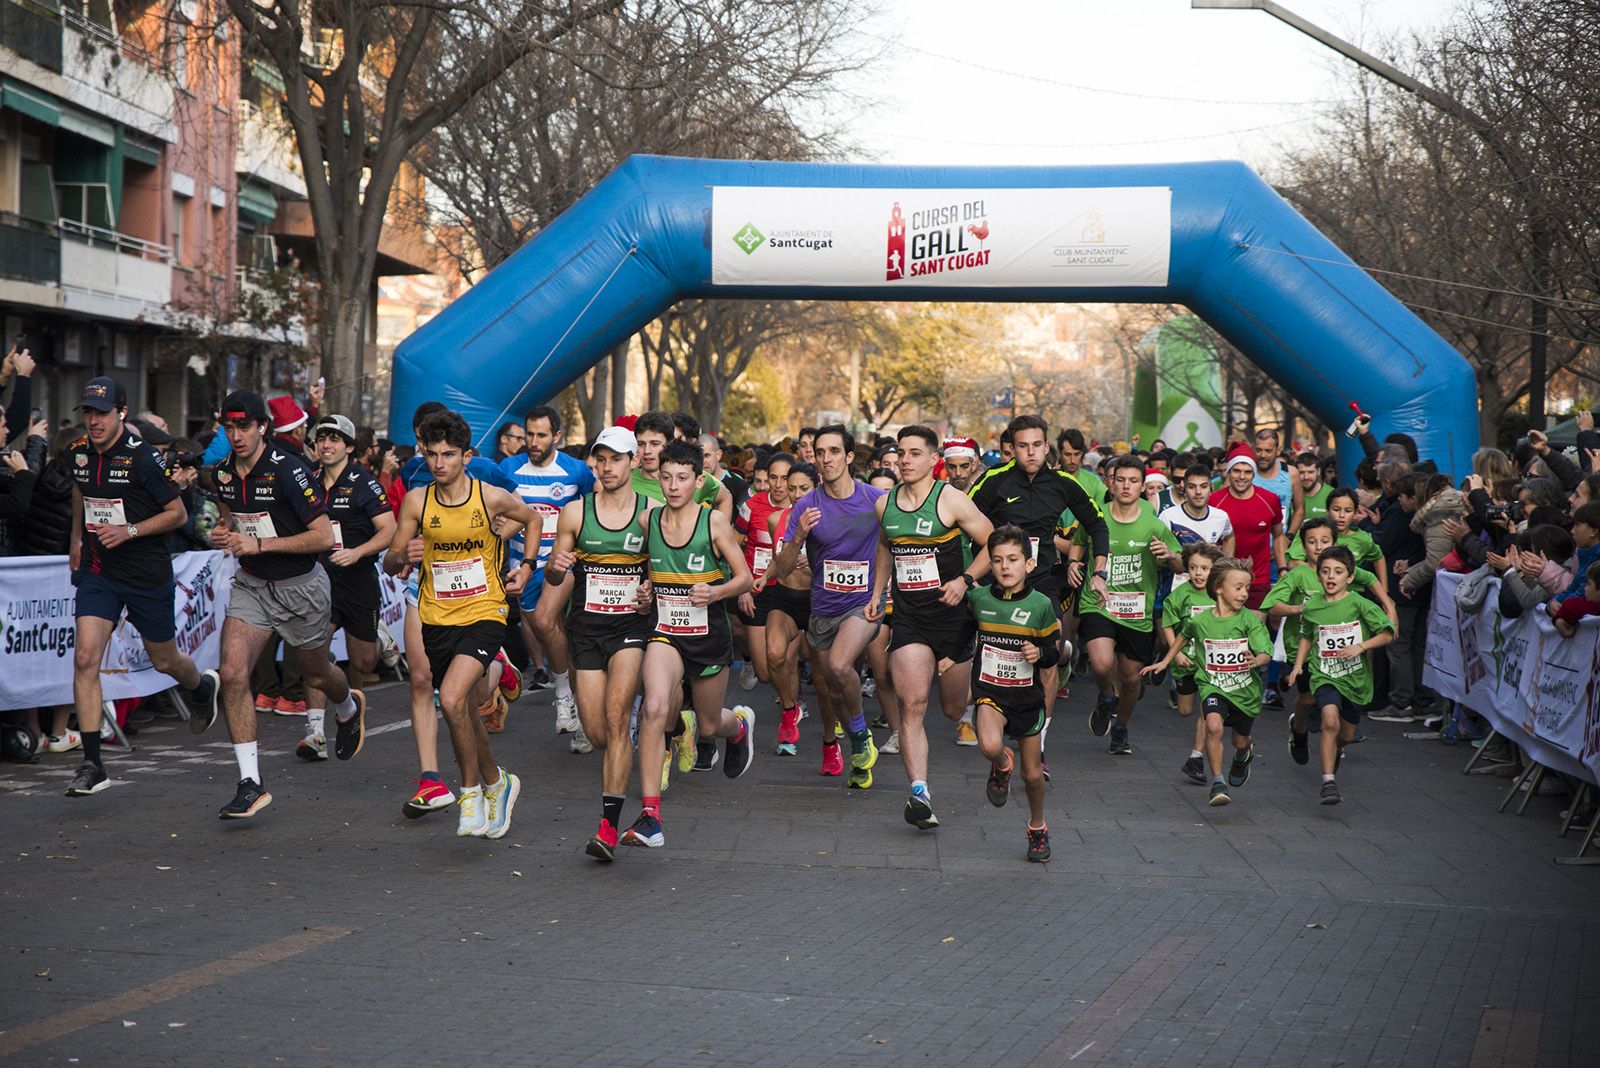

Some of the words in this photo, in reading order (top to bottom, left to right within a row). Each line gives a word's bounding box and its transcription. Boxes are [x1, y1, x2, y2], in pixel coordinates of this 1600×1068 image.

[912, 205, 958, 230] CURSA
[963, 200, 987, 221] DEL
[769, 230, 821, 238] AJUNTAMENT
[769, 238, 833, 251] SantCugat
[911, 226, 969, 260] GALL
[1054, 248, 1073, 256] CLUB
[1074, 248, 1128, 256] MUNTANYENC
[910, 258, 945, 277] SANT
[947, 249, 990, 271] CUGAT
[93, 510, 112, 518] MATIAS
[433, 538, 484, 553] ASMON
[1112, 562, 1135, 575] GALL
[828, 572, 864, 585] 1031
[450, 581, 469, 590] 811
[602, 597, 622, 605] 457
[7, 599, 69, 620] AJUNTAMENT
[670, 610, 690, 618] ADRIA
[671, 618, 690, 626] 376
[5, 623, 75, 658] SantCuga
[980, 635, 1025, 646] CERDANYOL
[1326, 635, 1356, 650] 937
[1208, 652, 1245, 665] 1320
[997, 663, 1017, 672] EIDEN
[996, 670, 1017, 679] 852
